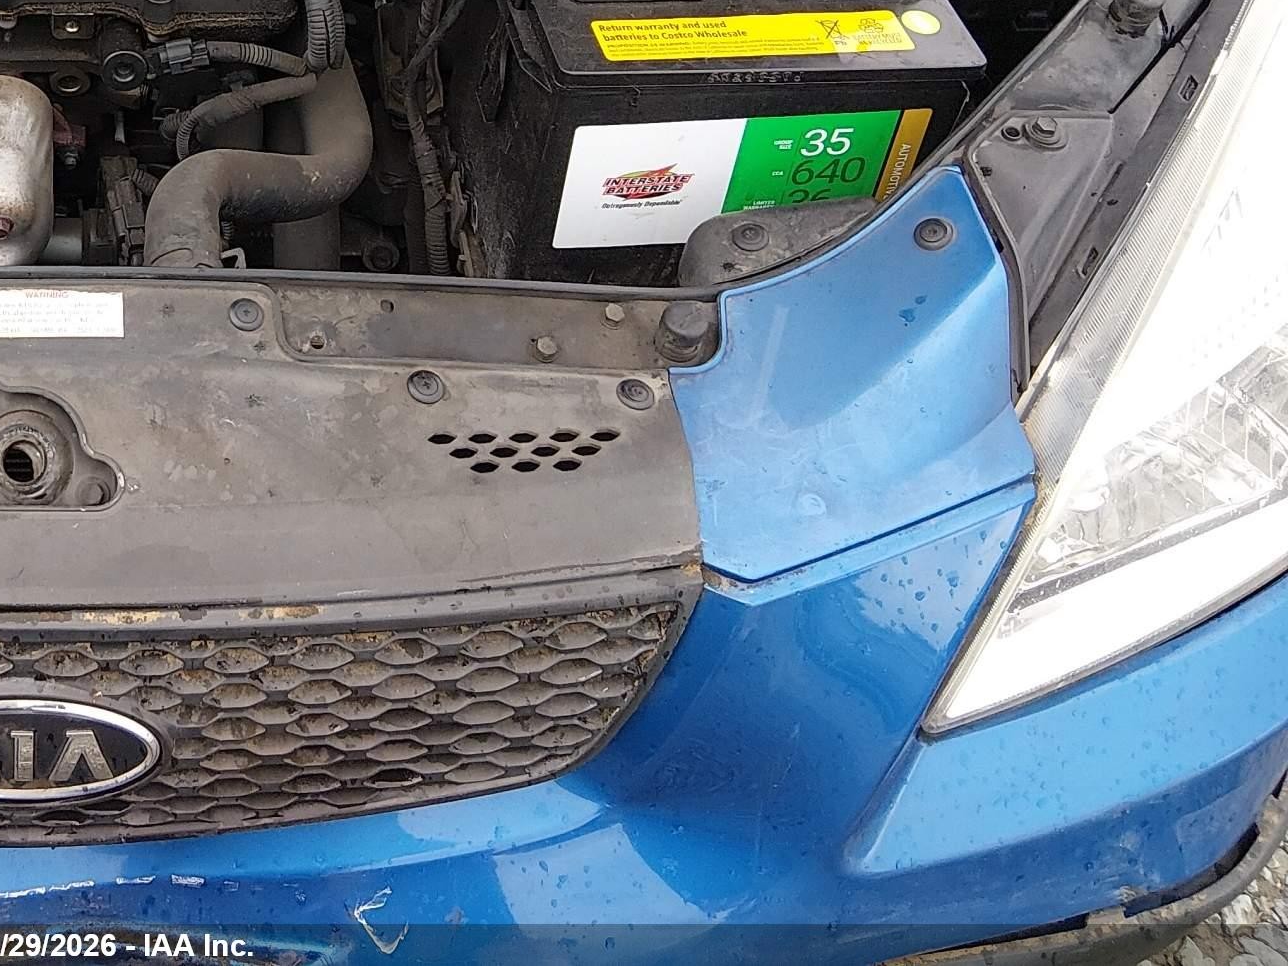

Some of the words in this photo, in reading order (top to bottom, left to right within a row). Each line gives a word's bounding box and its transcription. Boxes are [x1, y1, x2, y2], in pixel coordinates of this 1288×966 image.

[634, 23, 680, 32] warranty
[682, 21, 700, 29] and
[703, 20, 727, 28] used
[603, 33, 648, 41] batteries
[649, 32, 660, 40] to
[661, 31, 694, 40] Costco
[695, 29, 748, 38] Wholesale
[800, 128, 854, 156] 35
[791, 157, 865, 184] 640
[604, 175, 691, 186] INTERSTATE
[606, 183, 681, 194] BATTERIES
